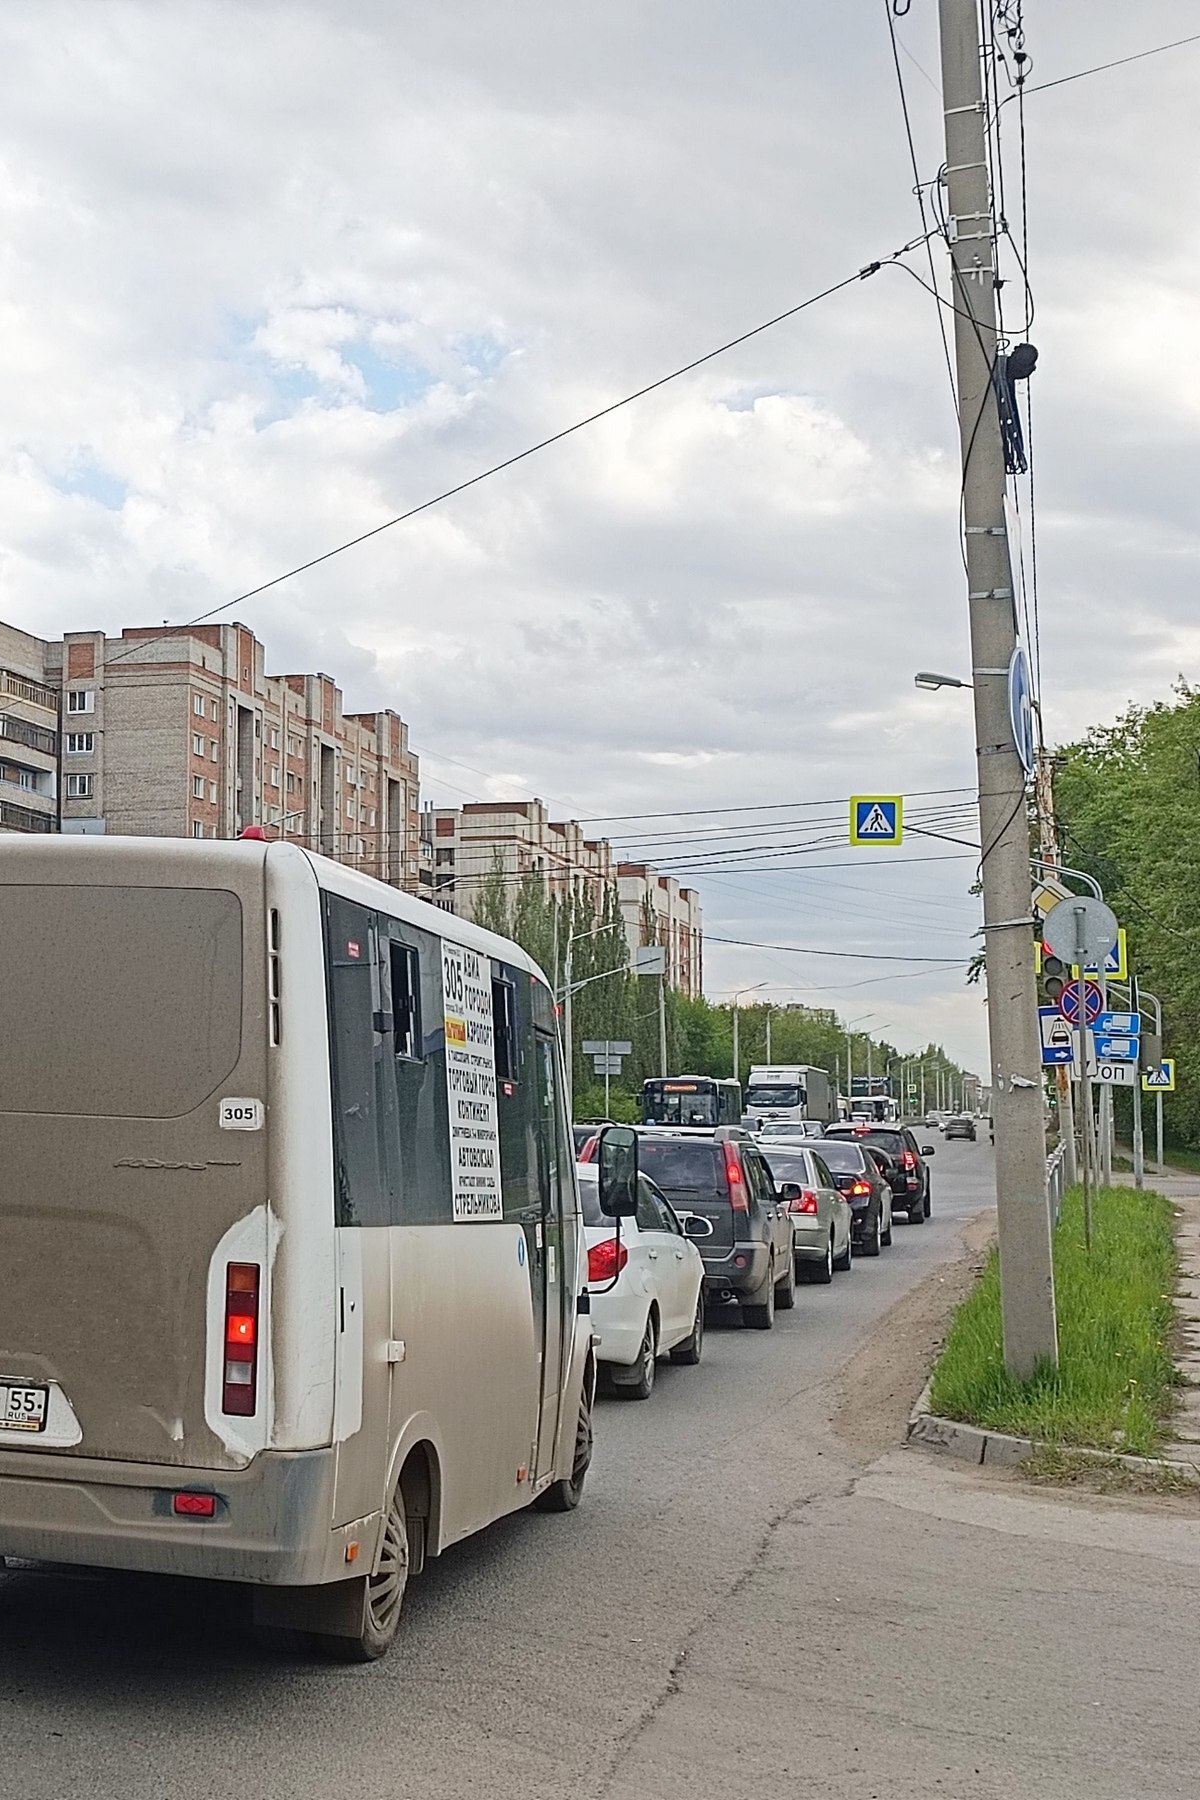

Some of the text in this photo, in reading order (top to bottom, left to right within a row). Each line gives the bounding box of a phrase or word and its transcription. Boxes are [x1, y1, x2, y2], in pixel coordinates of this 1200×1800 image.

[444, 956, 463, 1002] 305
[224, 1108, 254, 1120] 305
[10, 1391, 36, 1412] 55
[8, 1411, 27, 1421] RUS
